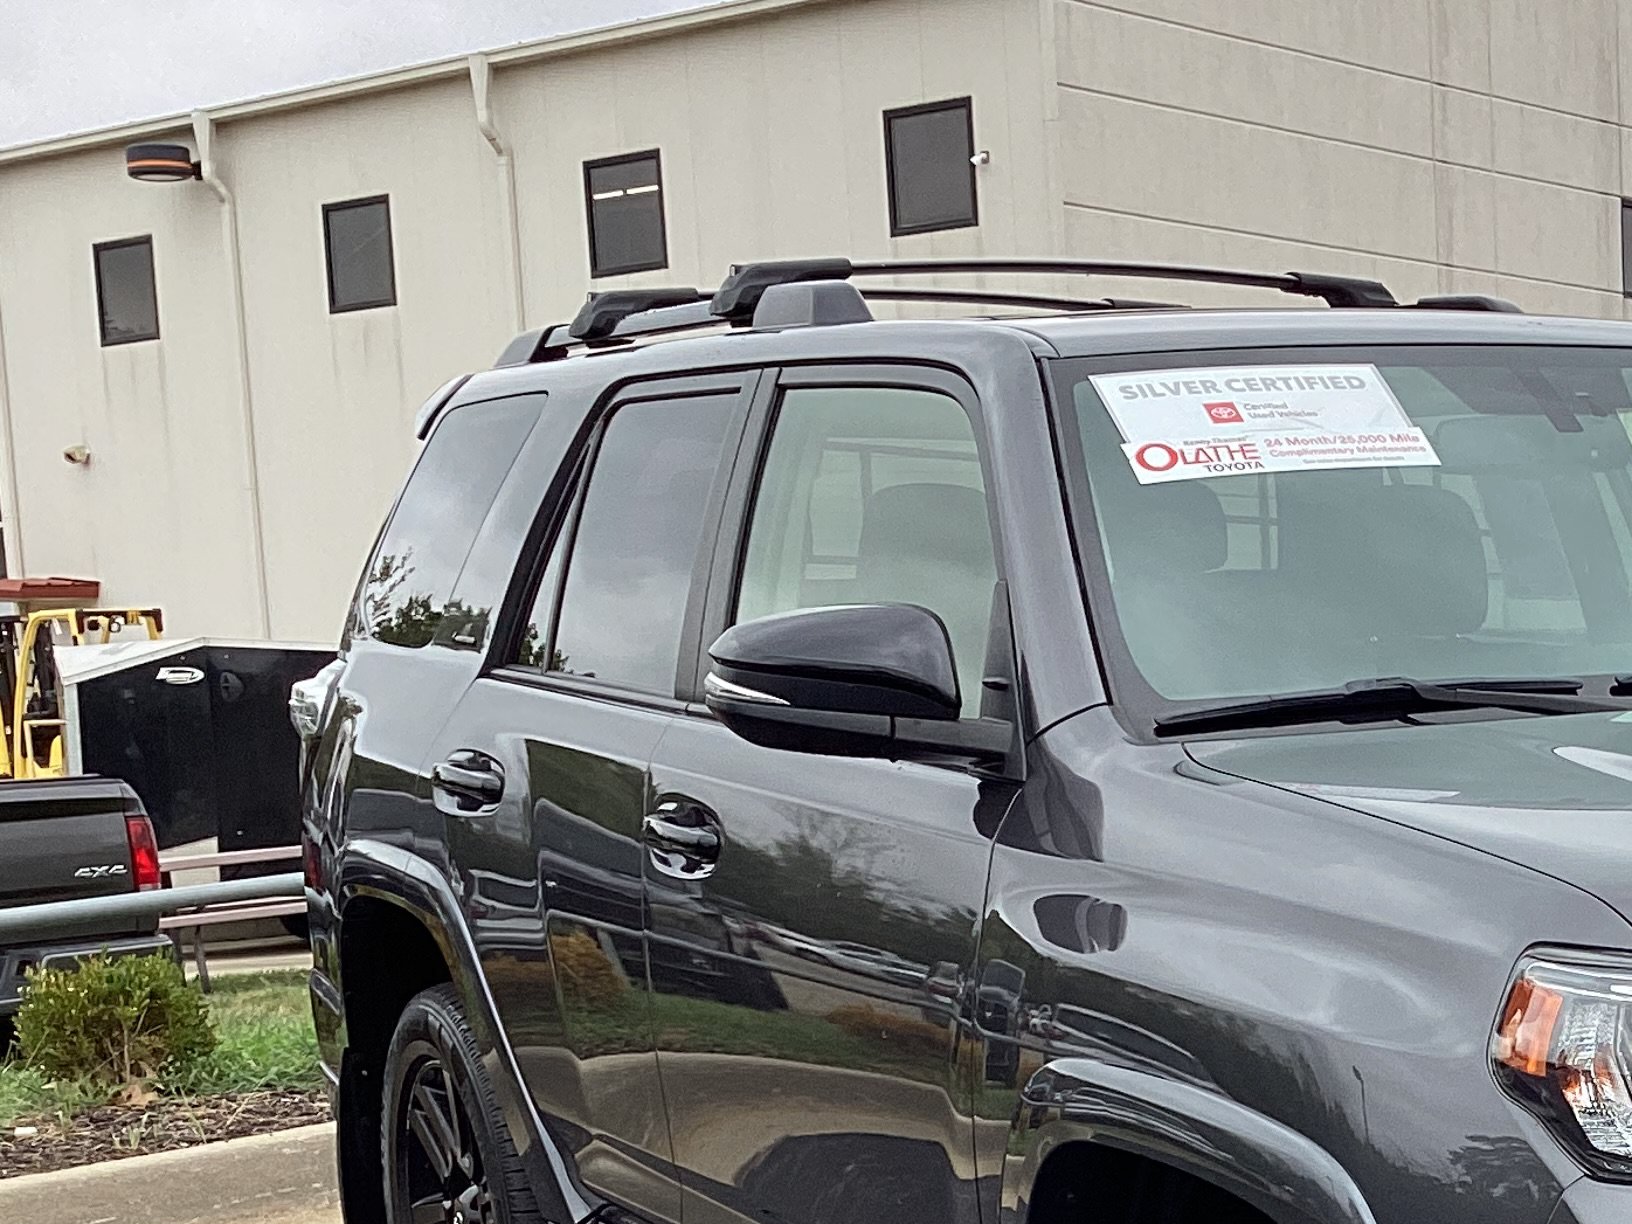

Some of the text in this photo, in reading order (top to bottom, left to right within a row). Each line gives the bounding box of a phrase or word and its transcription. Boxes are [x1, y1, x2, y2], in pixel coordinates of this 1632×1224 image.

[1118, 375, 1368, 401] SILVER CERTIFIED
[1263, 438, 1283, 448] 24
[1389, 433, 1420, 443] Mile
[1135, 443, 1262, 472] OLATHE
[1203, 461, 1265, 473] TOYOTA
